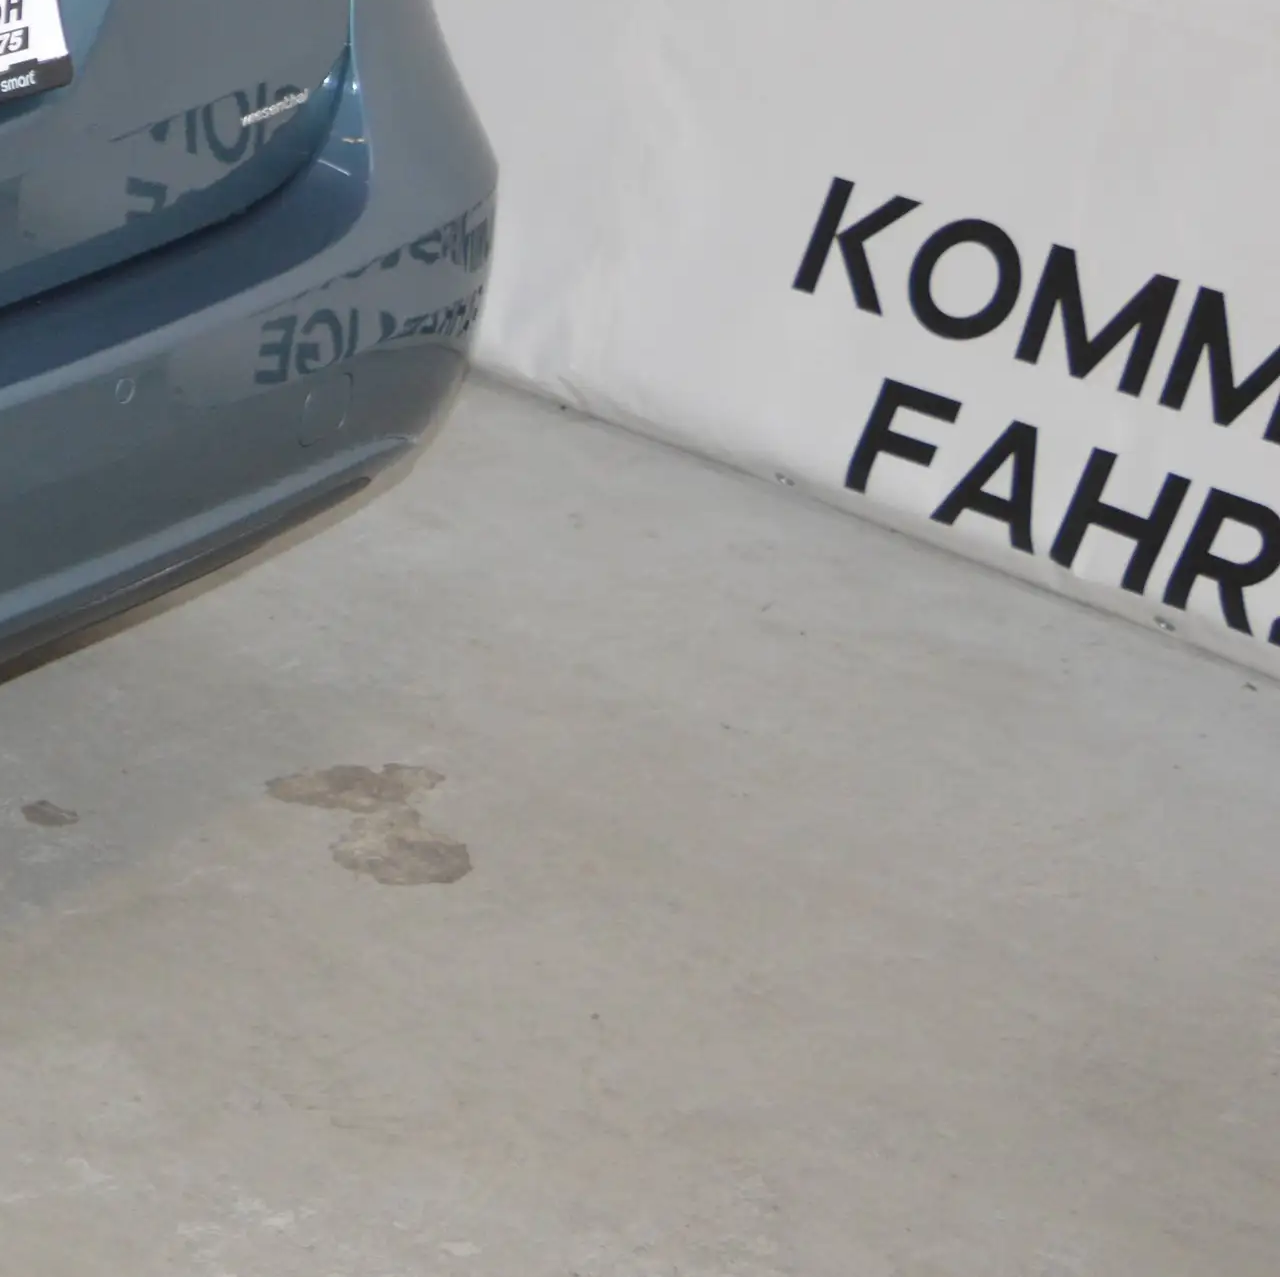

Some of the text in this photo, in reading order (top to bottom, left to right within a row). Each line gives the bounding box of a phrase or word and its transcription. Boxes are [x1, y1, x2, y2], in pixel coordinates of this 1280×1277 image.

[0, 70, 36, 92] smart
[791, 175, 1280, 446] KOMM
[844, 376, 1280, 648] FAHR
